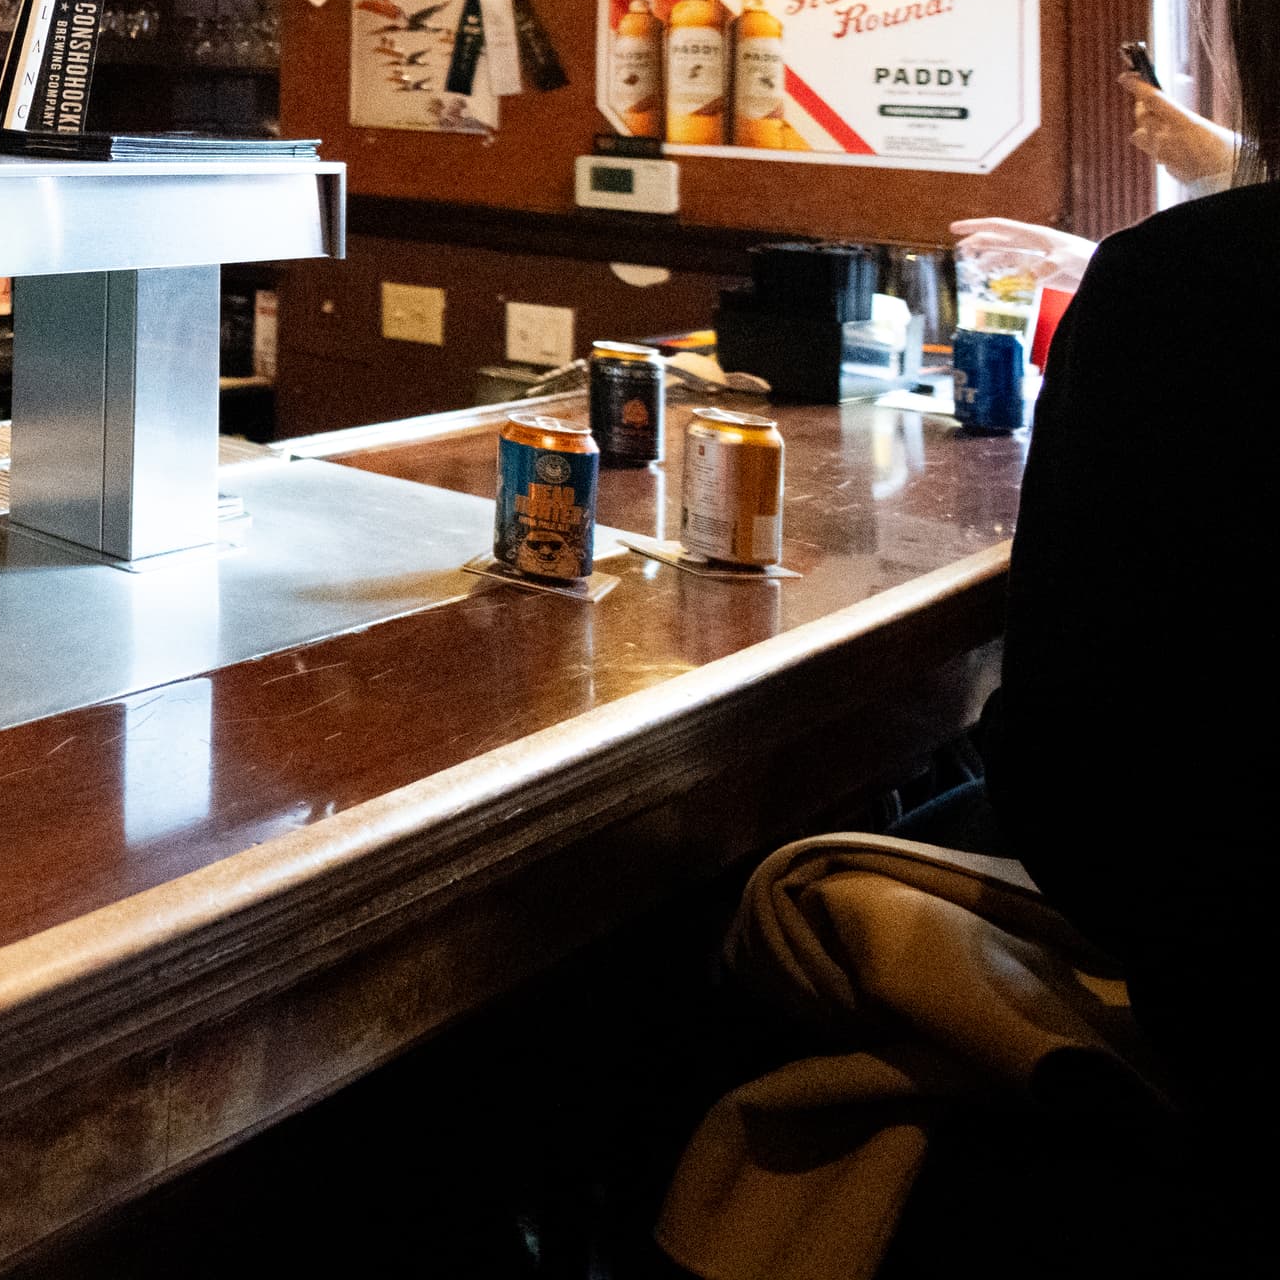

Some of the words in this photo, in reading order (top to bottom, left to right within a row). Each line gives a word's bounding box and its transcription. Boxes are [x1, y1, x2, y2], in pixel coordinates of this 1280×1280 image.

[49, 20, 69, 71] BREWING
[42, 73, 62, 128] COMPANY
[874, 67, 974, 87] PADDY
